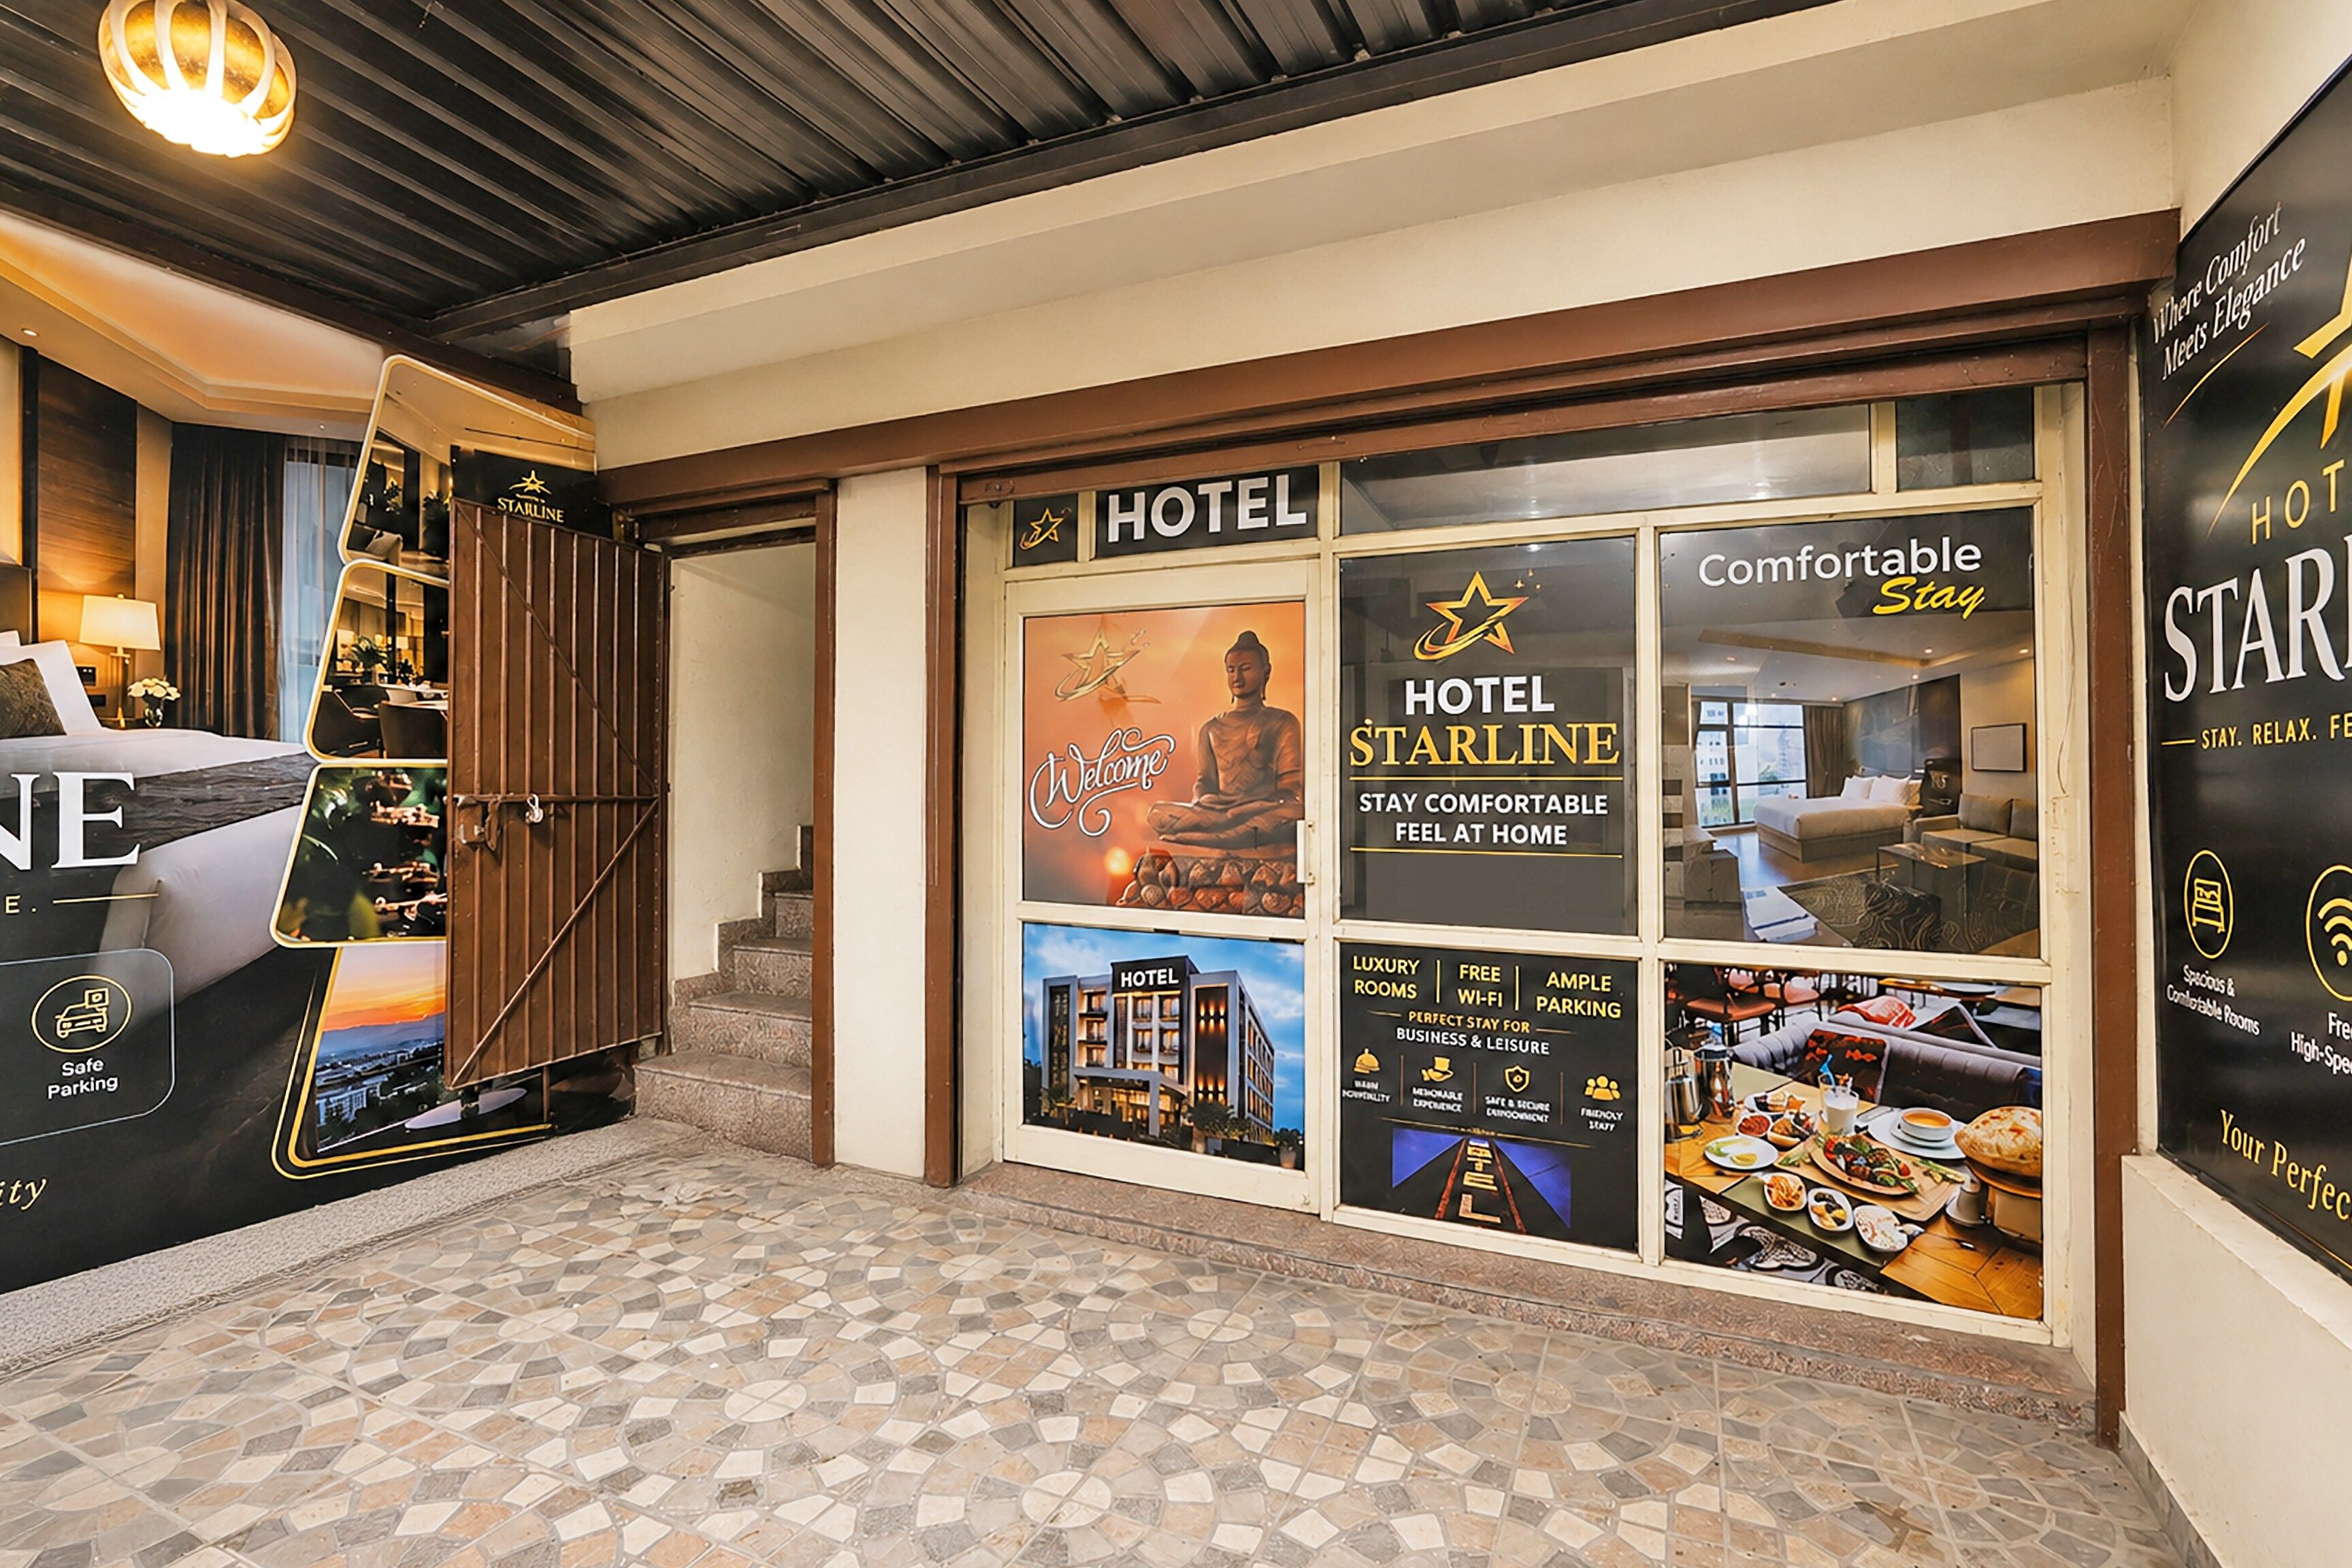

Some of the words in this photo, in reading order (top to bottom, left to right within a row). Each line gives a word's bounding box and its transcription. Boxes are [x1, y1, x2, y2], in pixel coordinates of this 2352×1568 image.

[2153, 281, 2202, 344] Where
[2206, 202, 2282, 296] Comfort
[2161, 321, 2207, 381] Meets
[2212, 238, 2306, 330] Elegance
[497, 497, 564, 523] STARLINE
[1108, 474, 1307, 543] HOTEL
[1699, 536, 1982, 587] Comfortable
[1873, 576, 1985, 619] Stay
[1405, 675, 1555, 715] HOTEL
[1350, 723, 1620, 766] STARLINE
[2201, 727, 2242, 749] STAY.
[2253, 718, 2317, 745] RELAX.
[1030, 728, 1175, 836] Welcome
[1360, 793, 1418, 813] STAY
[1424, 794, 1608, 815] COMFORTABLE
[1396, 822, 1447, 842] FEEL
[1453, 823, 1485, 843] AT
[1492, 823, 1567, 845] HOME
[1121, 968, 1179, 987] HOTEL
[1353, 956, 1420, 975] LUXURY
[1460, 964, 1501, 982] FREE
[1354, 979, 1417, 998] ROOMS
[1546, 972, 1612, 992] AMPLE
[2226, 977, 2236, 998] &
[1458, 990, 1503, 1007] WI-FI
[1536, 997, 1622, 1018] PARKING
[1409, 1011, 1464, 1027] PERFECT
[1466, 1015, 1501, 1031] STAY
[1502, 1019, 1531, 1034] FOR
[2328, 1012, 2352, 1039] Fre
[1396, 1028, 1467, 1046] BUSINESS
[1471, 1035, 1482, 1049] &
[1487, 1039, 1550, 1056] LEISURE
[2291, 1031, 2352, 1075] High-Spe
[61, 1058, 104, 1077] Safe
[47, 1076, 118, 1099] Parking
[2221, 1109, 2266, 1164] Your
[2270, 1140, 2352, 1225] Perfec
